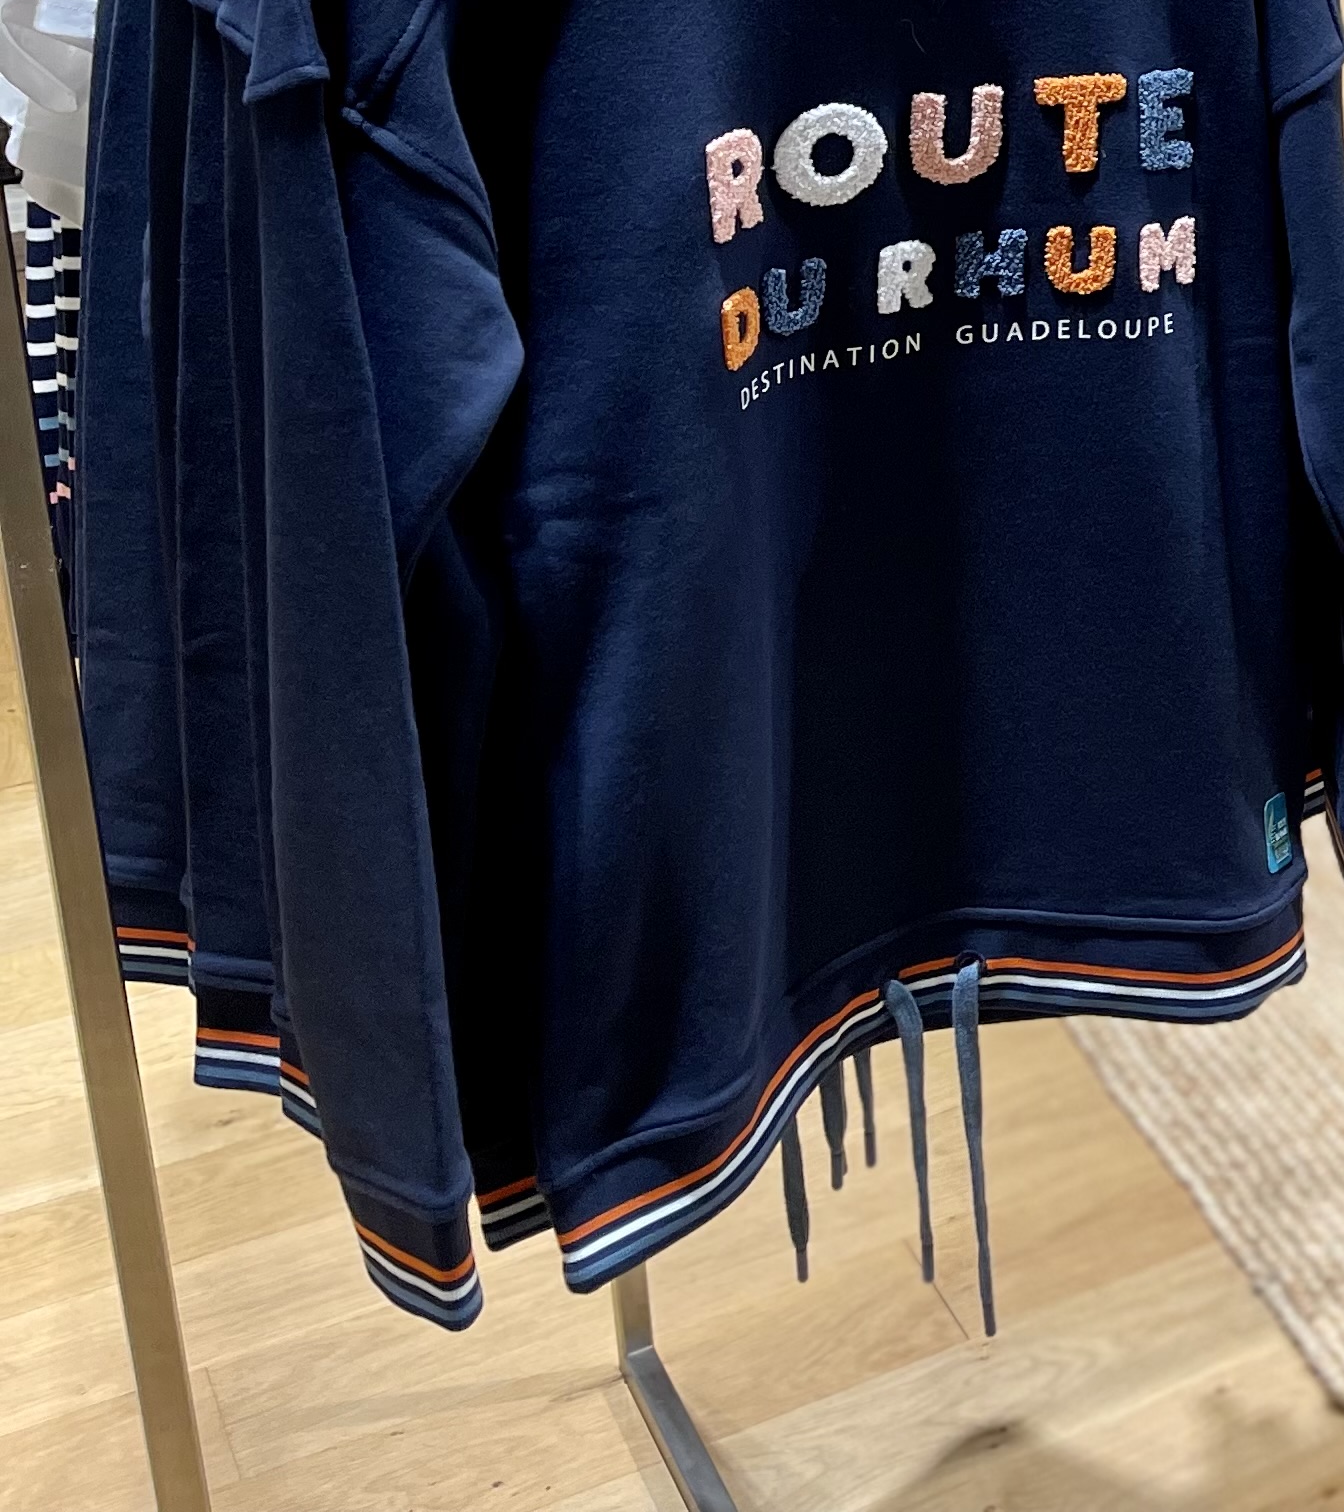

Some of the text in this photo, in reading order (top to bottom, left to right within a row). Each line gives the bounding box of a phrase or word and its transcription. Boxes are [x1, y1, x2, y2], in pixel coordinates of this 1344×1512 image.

[705, 67, 1195, 243] ROUTE
[720, 216, 1196, 371] DU RHUM
[740, 313, 1175, 410] DESTINATION GUADELOUPE
